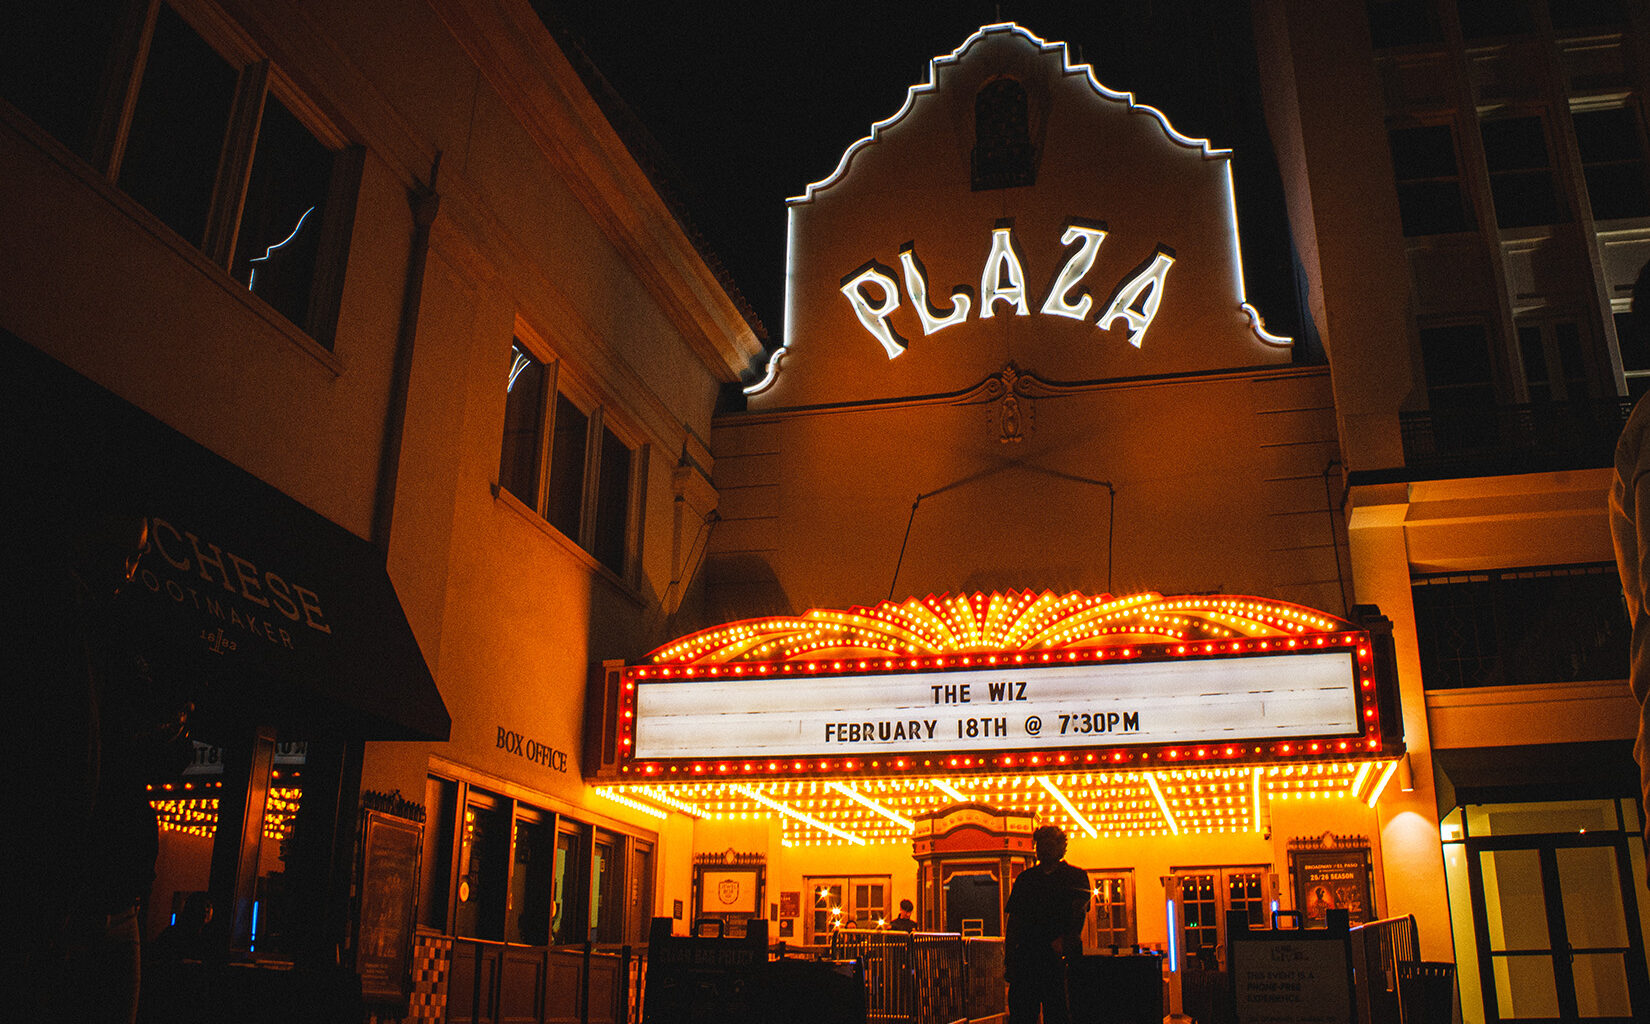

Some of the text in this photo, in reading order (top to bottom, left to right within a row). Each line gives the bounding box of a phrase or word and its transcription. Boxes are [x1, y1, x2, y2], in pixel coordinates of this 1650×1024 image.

[840, 222, 1176, 360] PLAZA
[146, 517, 332, 635] CHESE
[141, 568, 294, 650] OOTMAKER
[931, 681, 1028, 704] THE WIZ
[496, 725, 568, 773] BOX OFFICE
[825, 711, 1140, 742] FEBRUARY 18TH @ 7:30PM
[1330, 872, 1354, 880] SEASON
